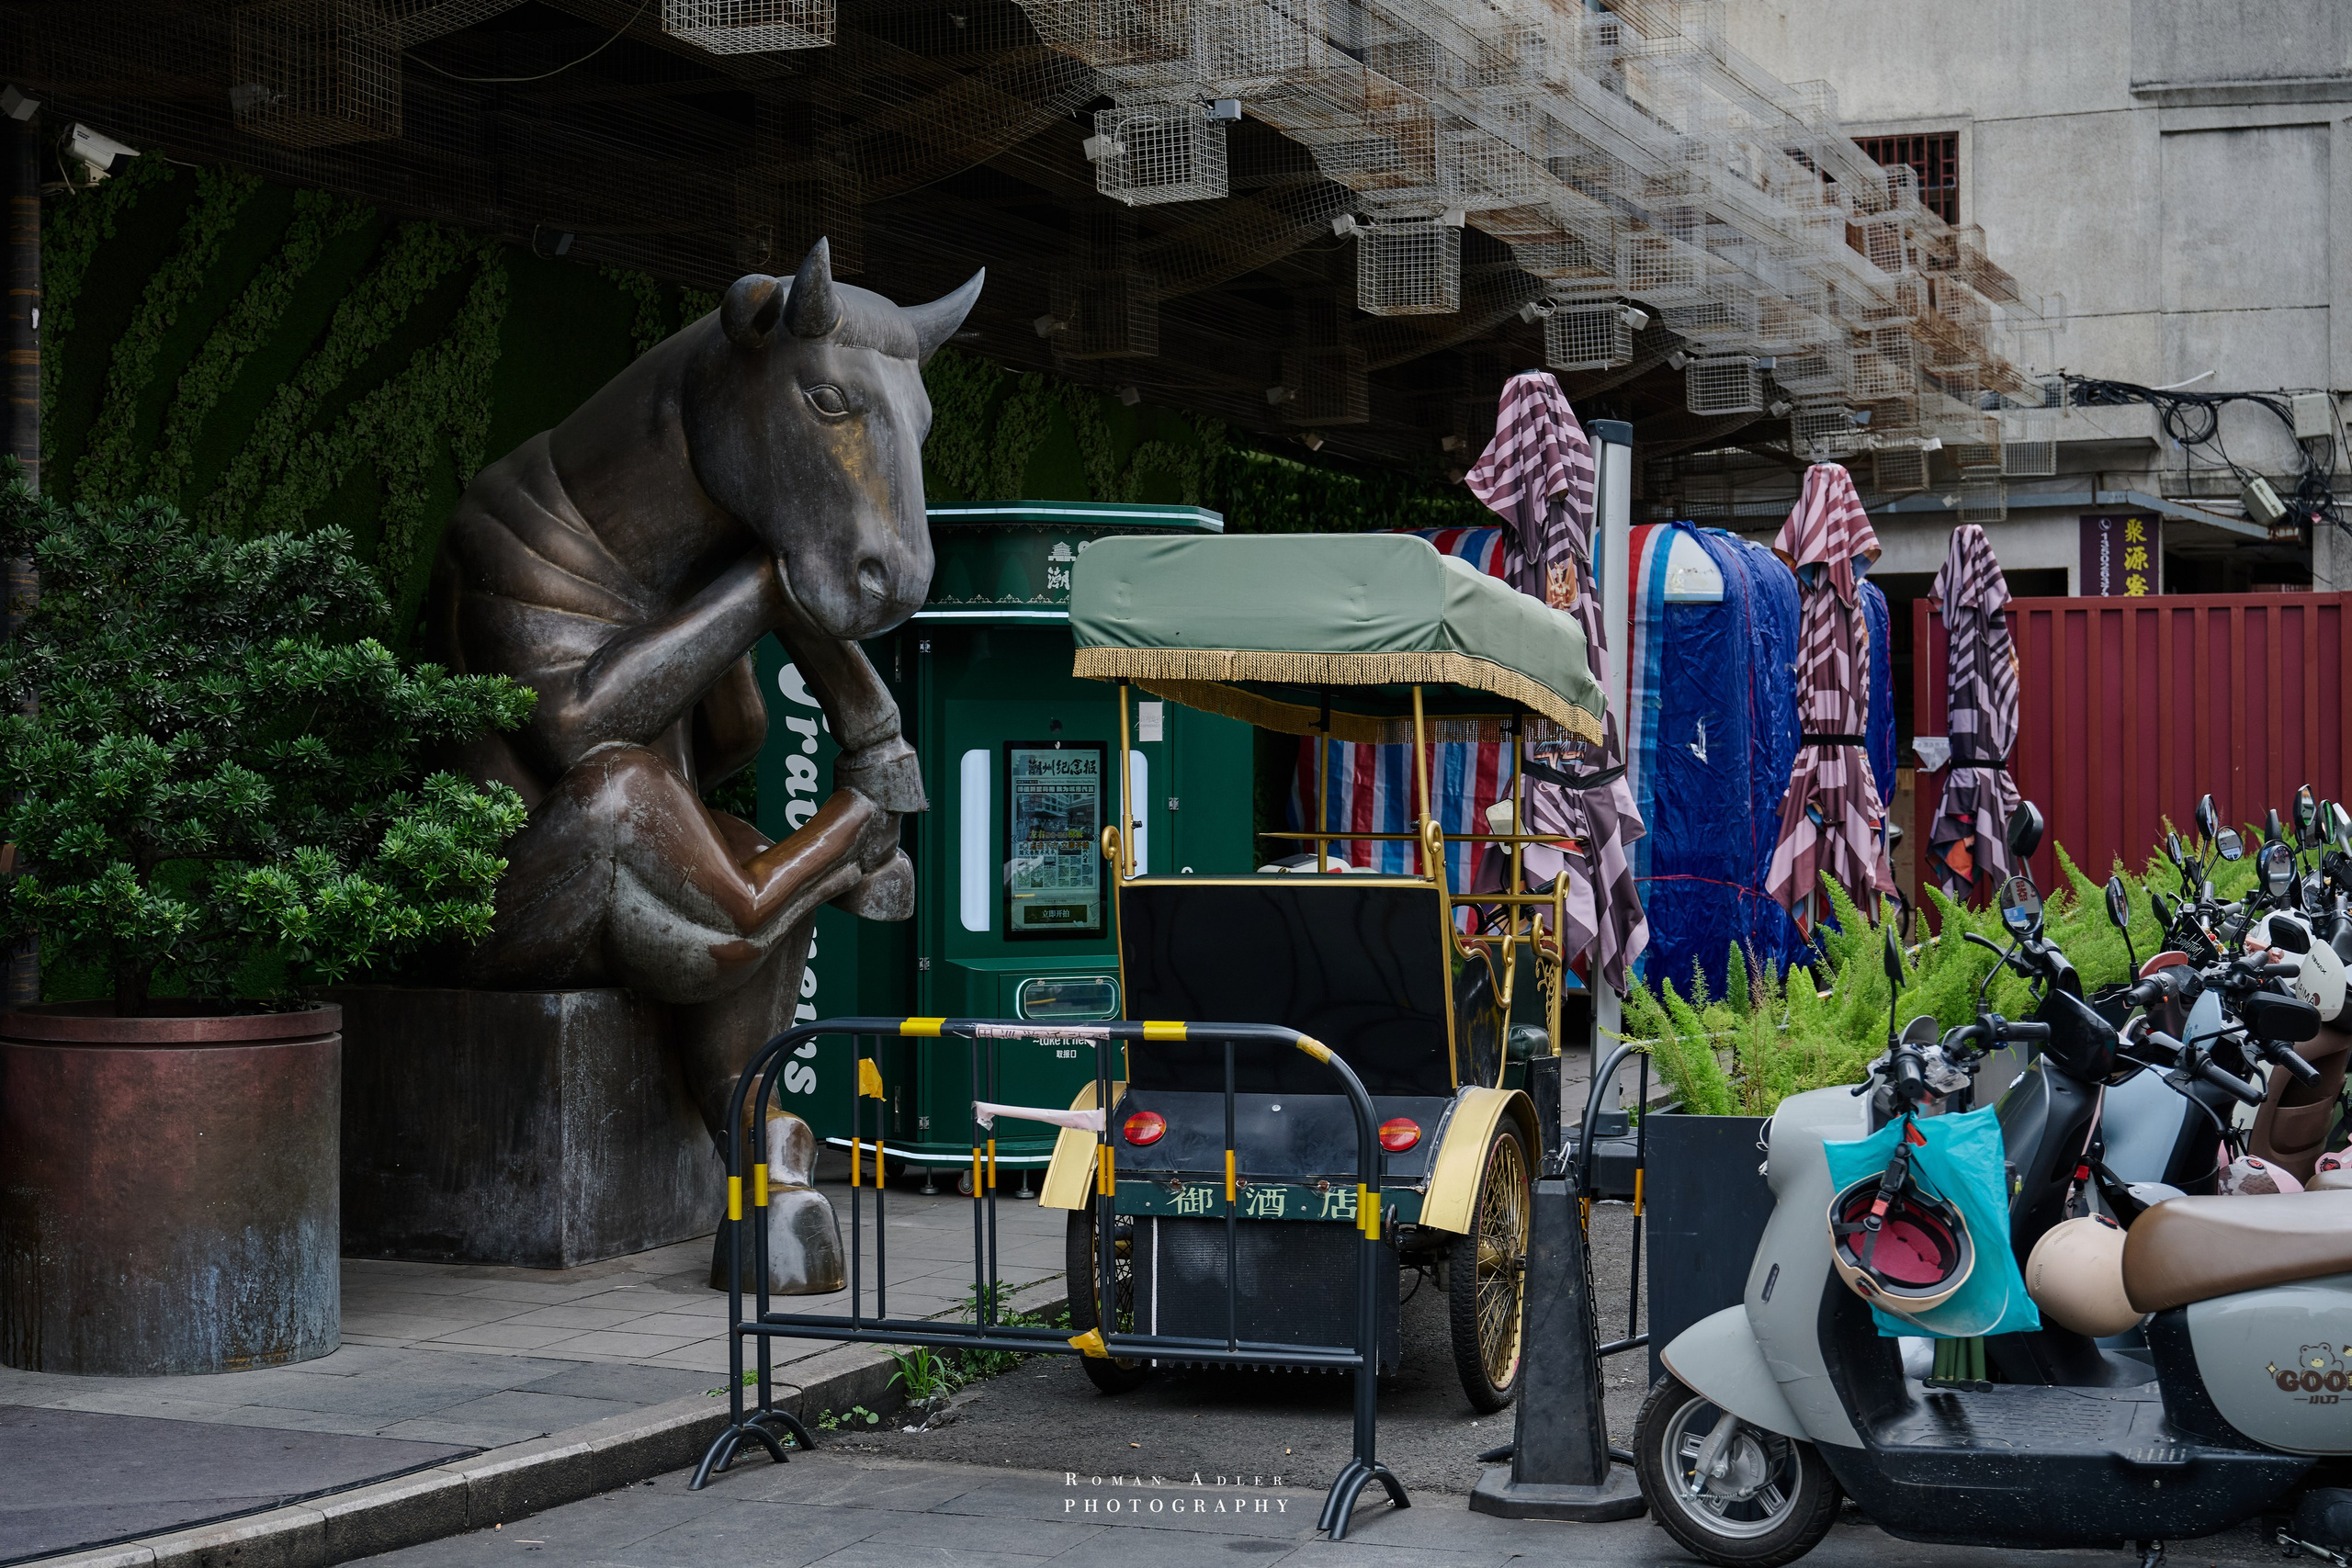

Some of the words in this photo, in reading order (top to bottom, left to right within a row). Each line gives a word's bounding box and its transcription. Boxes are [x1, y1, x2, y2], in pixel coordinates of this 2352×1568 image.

[1042, 909, 1070, 919] 立即开拍
[1057, 1049, 1077, 1058] 取报口
